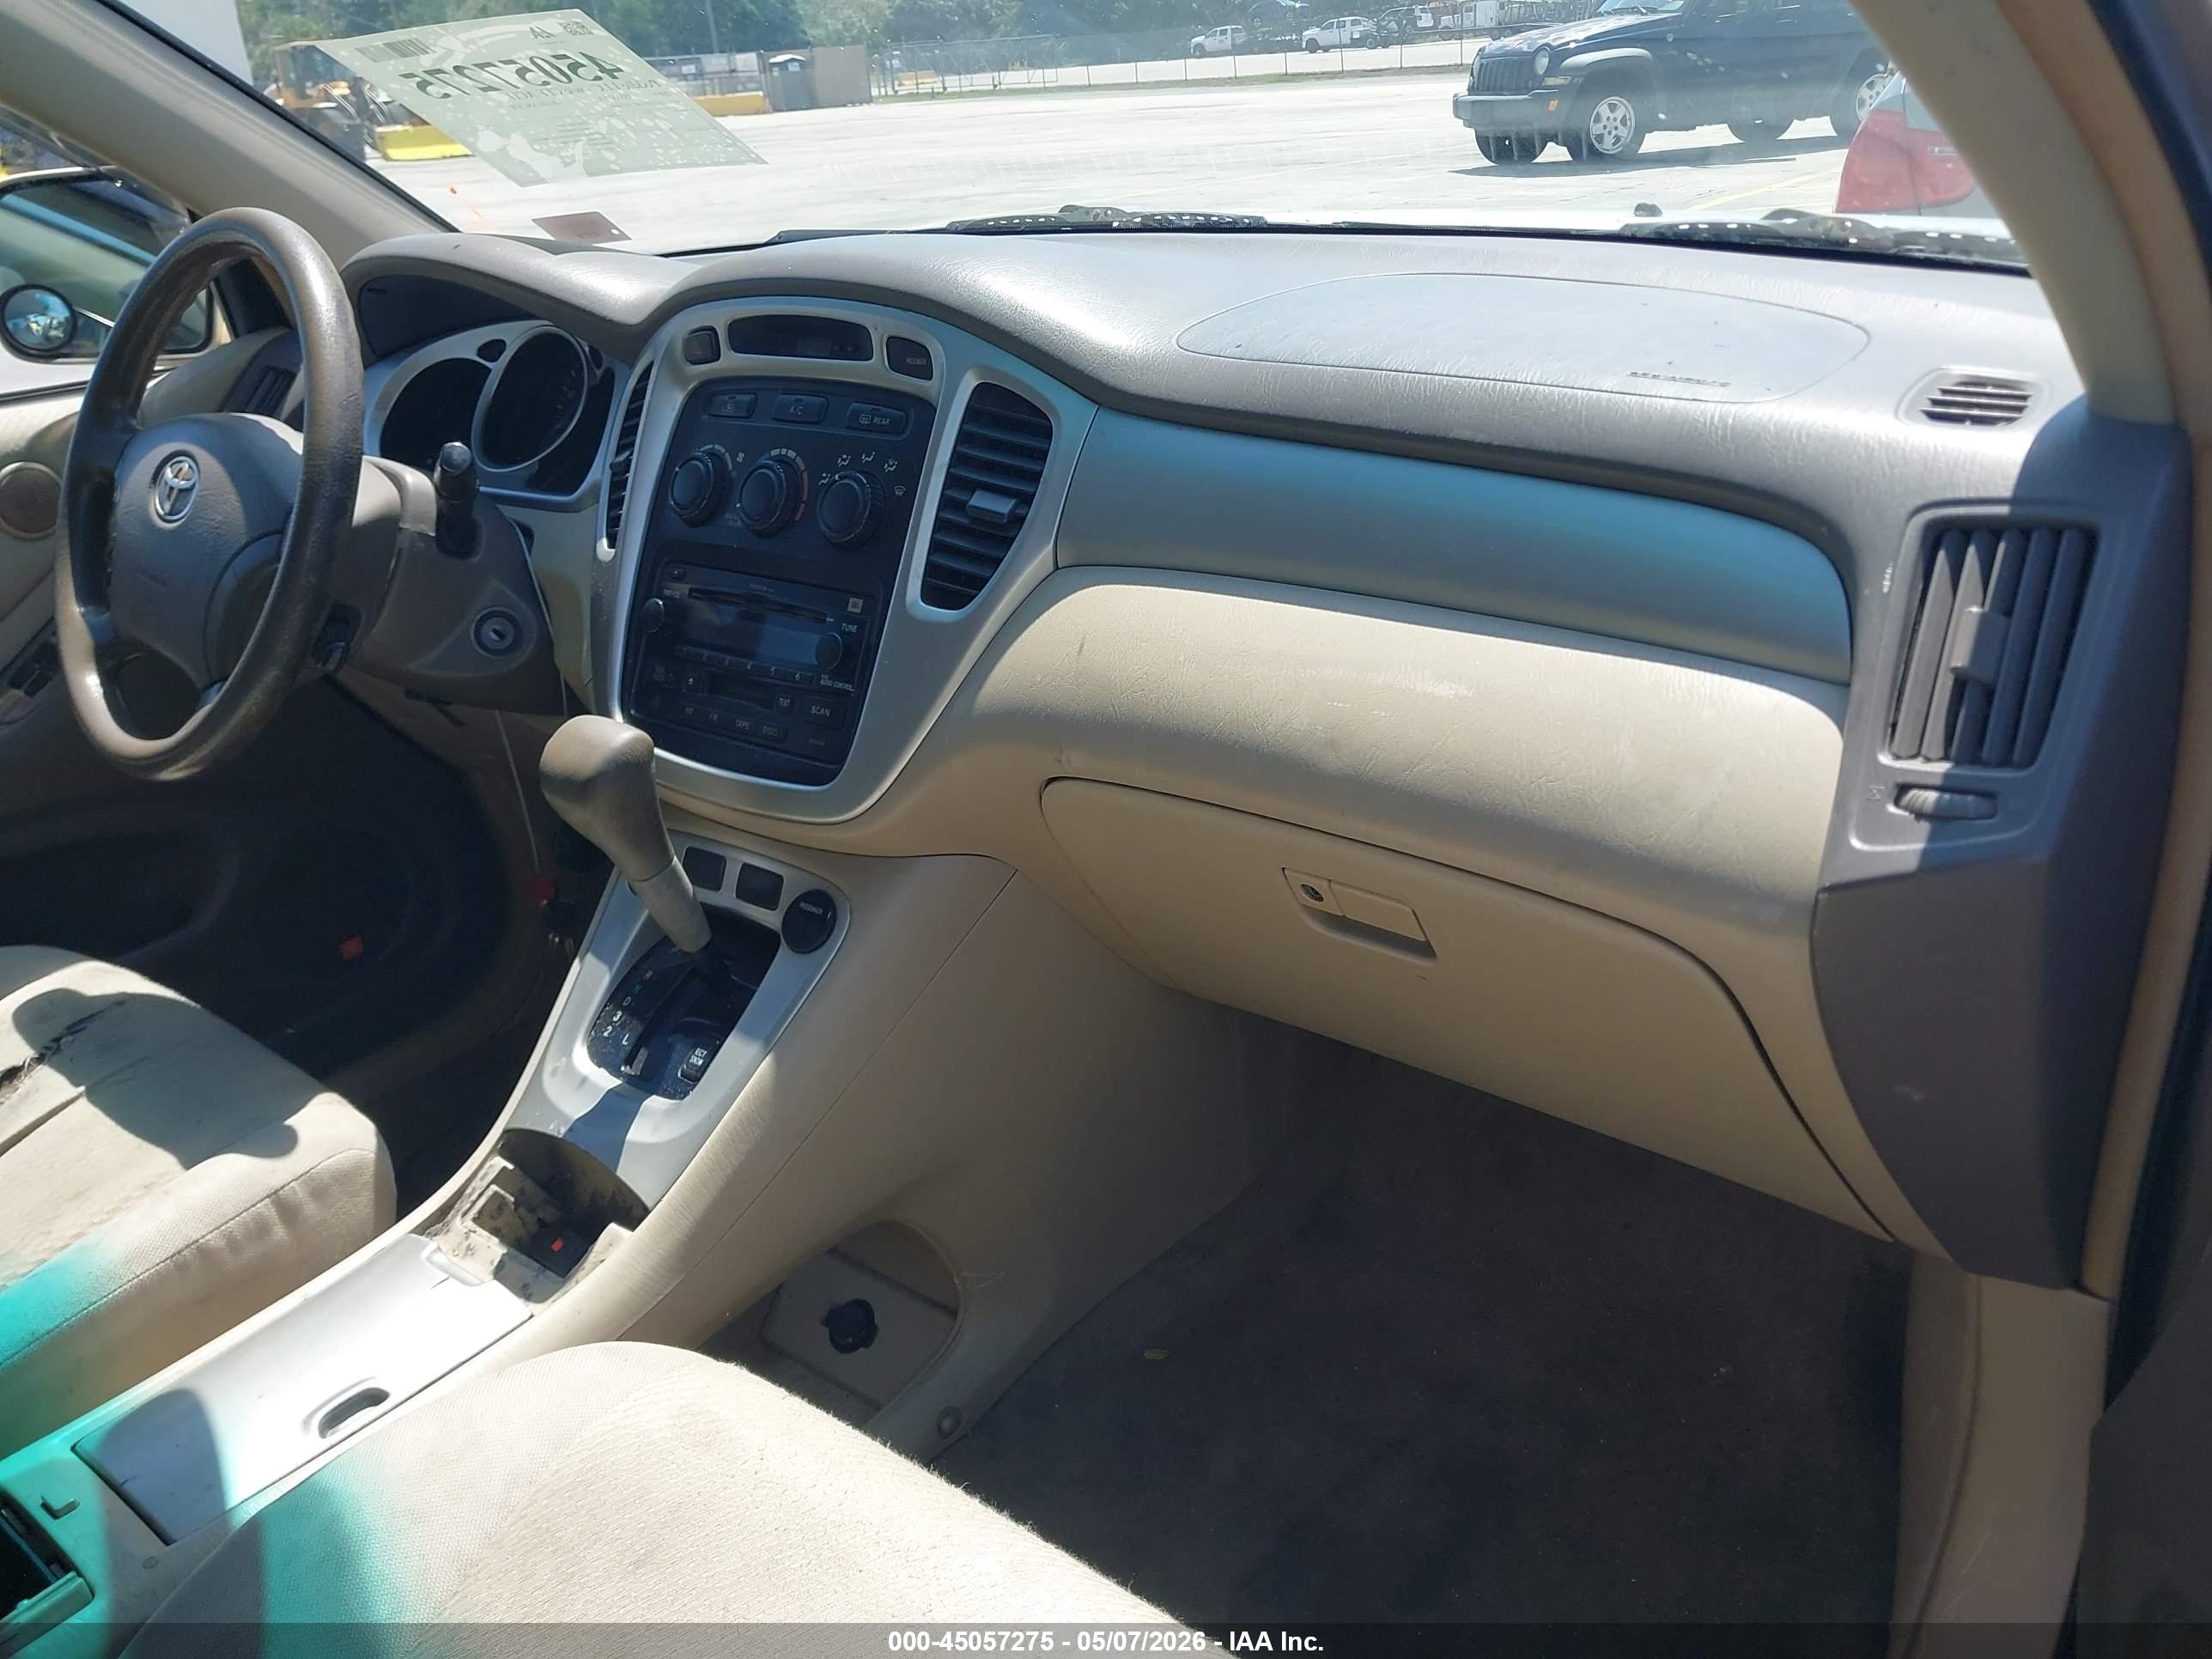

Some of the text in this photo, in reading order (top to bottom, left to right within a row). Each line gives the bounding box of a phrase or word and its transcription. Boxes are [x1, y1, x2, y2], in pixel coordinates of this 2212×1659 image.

[789, 405, 804, 416] A/C
[873, 416, 890, 427] REAR
[842, 623, 858, 633] TUNE
[778, 697, 791, 708] TEXT
[811, 704, 831, 718] SCAN
[735, 719, 750, 731] TAPE
[643, 969, 653, 981] R
[623, 996, 632, 1006] D
[612, 1011, 623, 1022] 3
[603, 1025, 613, 1037] 2
[622, 1033, 630, 1046] L
[695, 1048, 708, 1059] ECT
[689, 1054, 704, 1066] SNOW
